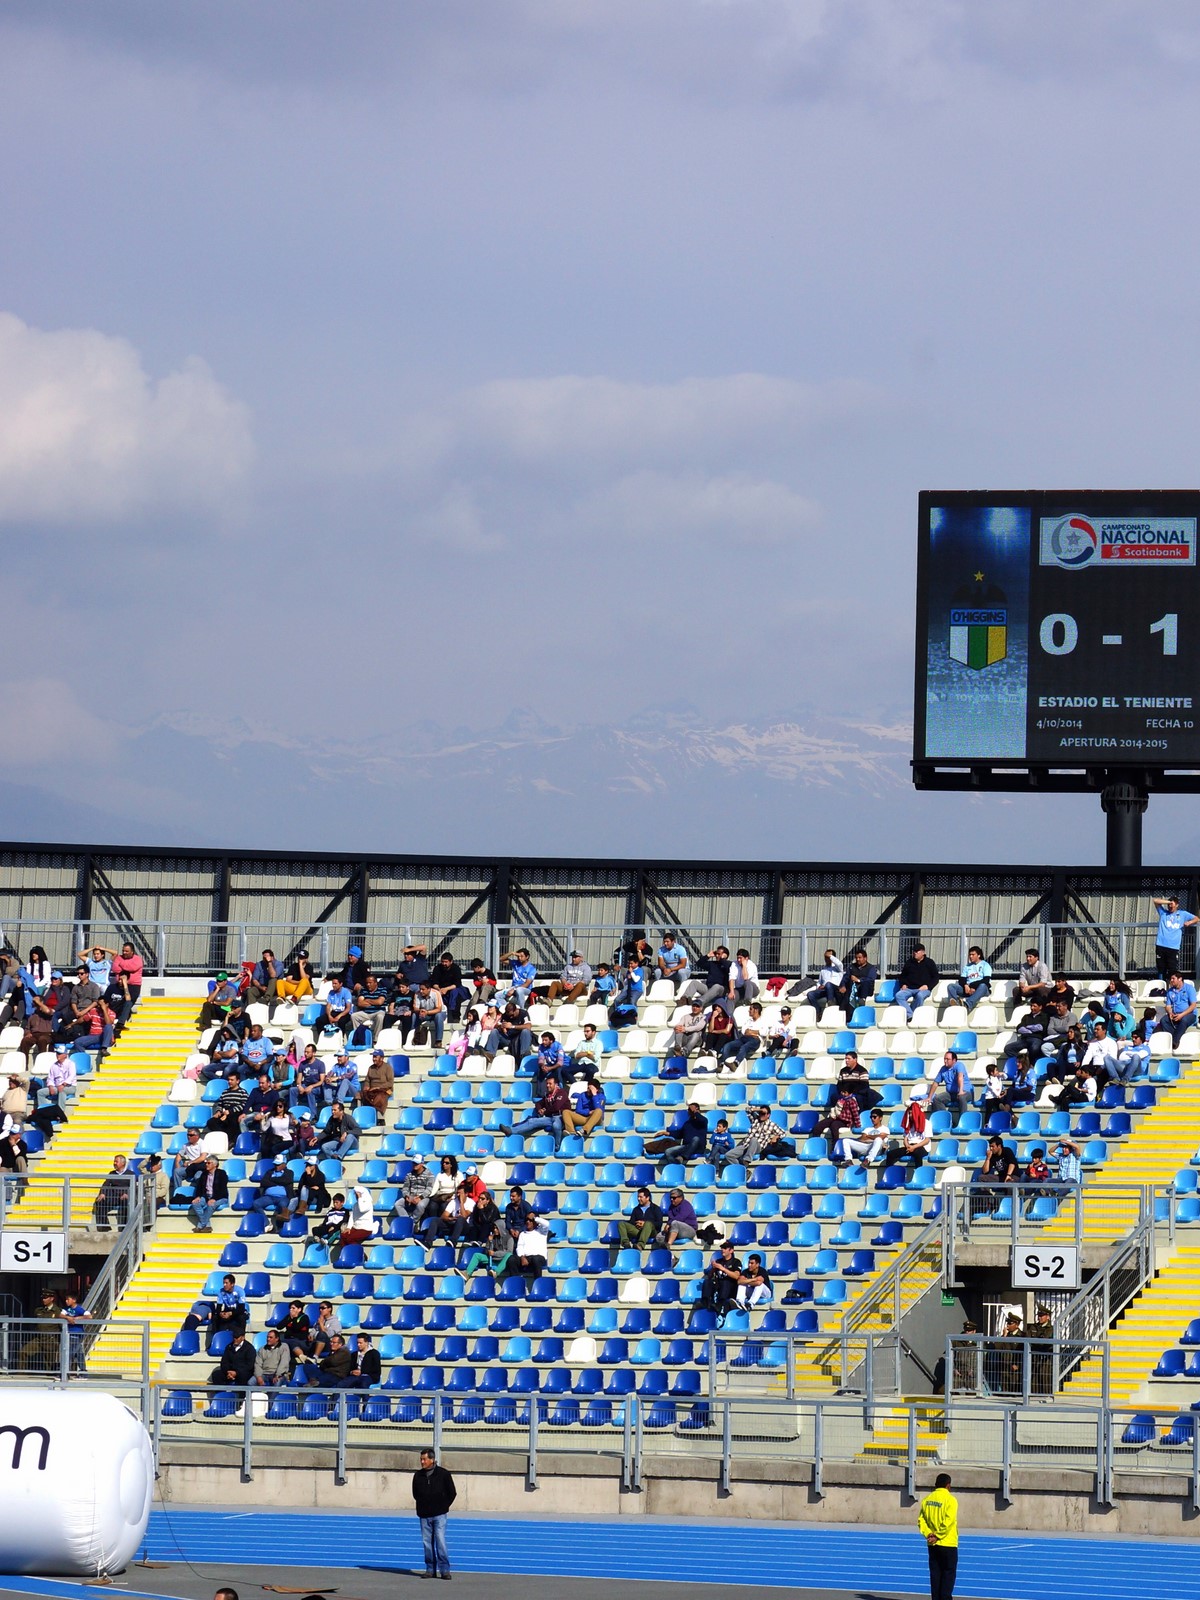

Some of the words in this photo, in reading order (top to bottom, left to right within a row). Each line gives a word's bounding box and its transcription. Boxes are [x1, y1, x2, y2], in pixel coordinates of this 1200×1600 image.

[1101, 530, 1189, 544] NACIONAL
[1125, 547, 1182, 556] Scotiabank
[952, 611, 1005, 623] O'HIGGINS
[1039, 613, 1079, 656] 0
[1150, 613, 1178, 656] 1
[1038, 697, 1098, 708] ESTADIO
[1102, 697, 1119, 708] EL
[1123, 697, 1193, 709] TENIENTE
[1036, 718, 1083, 730] 4/10/2014
[1146, 719, 1181, 728] FECHA
[1183, 720, 1194, 729] 10
[1059, 737, 1117, 747] APERTURA
[1119, 739, 1168, 749] 2014-2015
[14, 1240, 53, 1264] S-1
[1024, 1254, 1065, 1279] S-2
